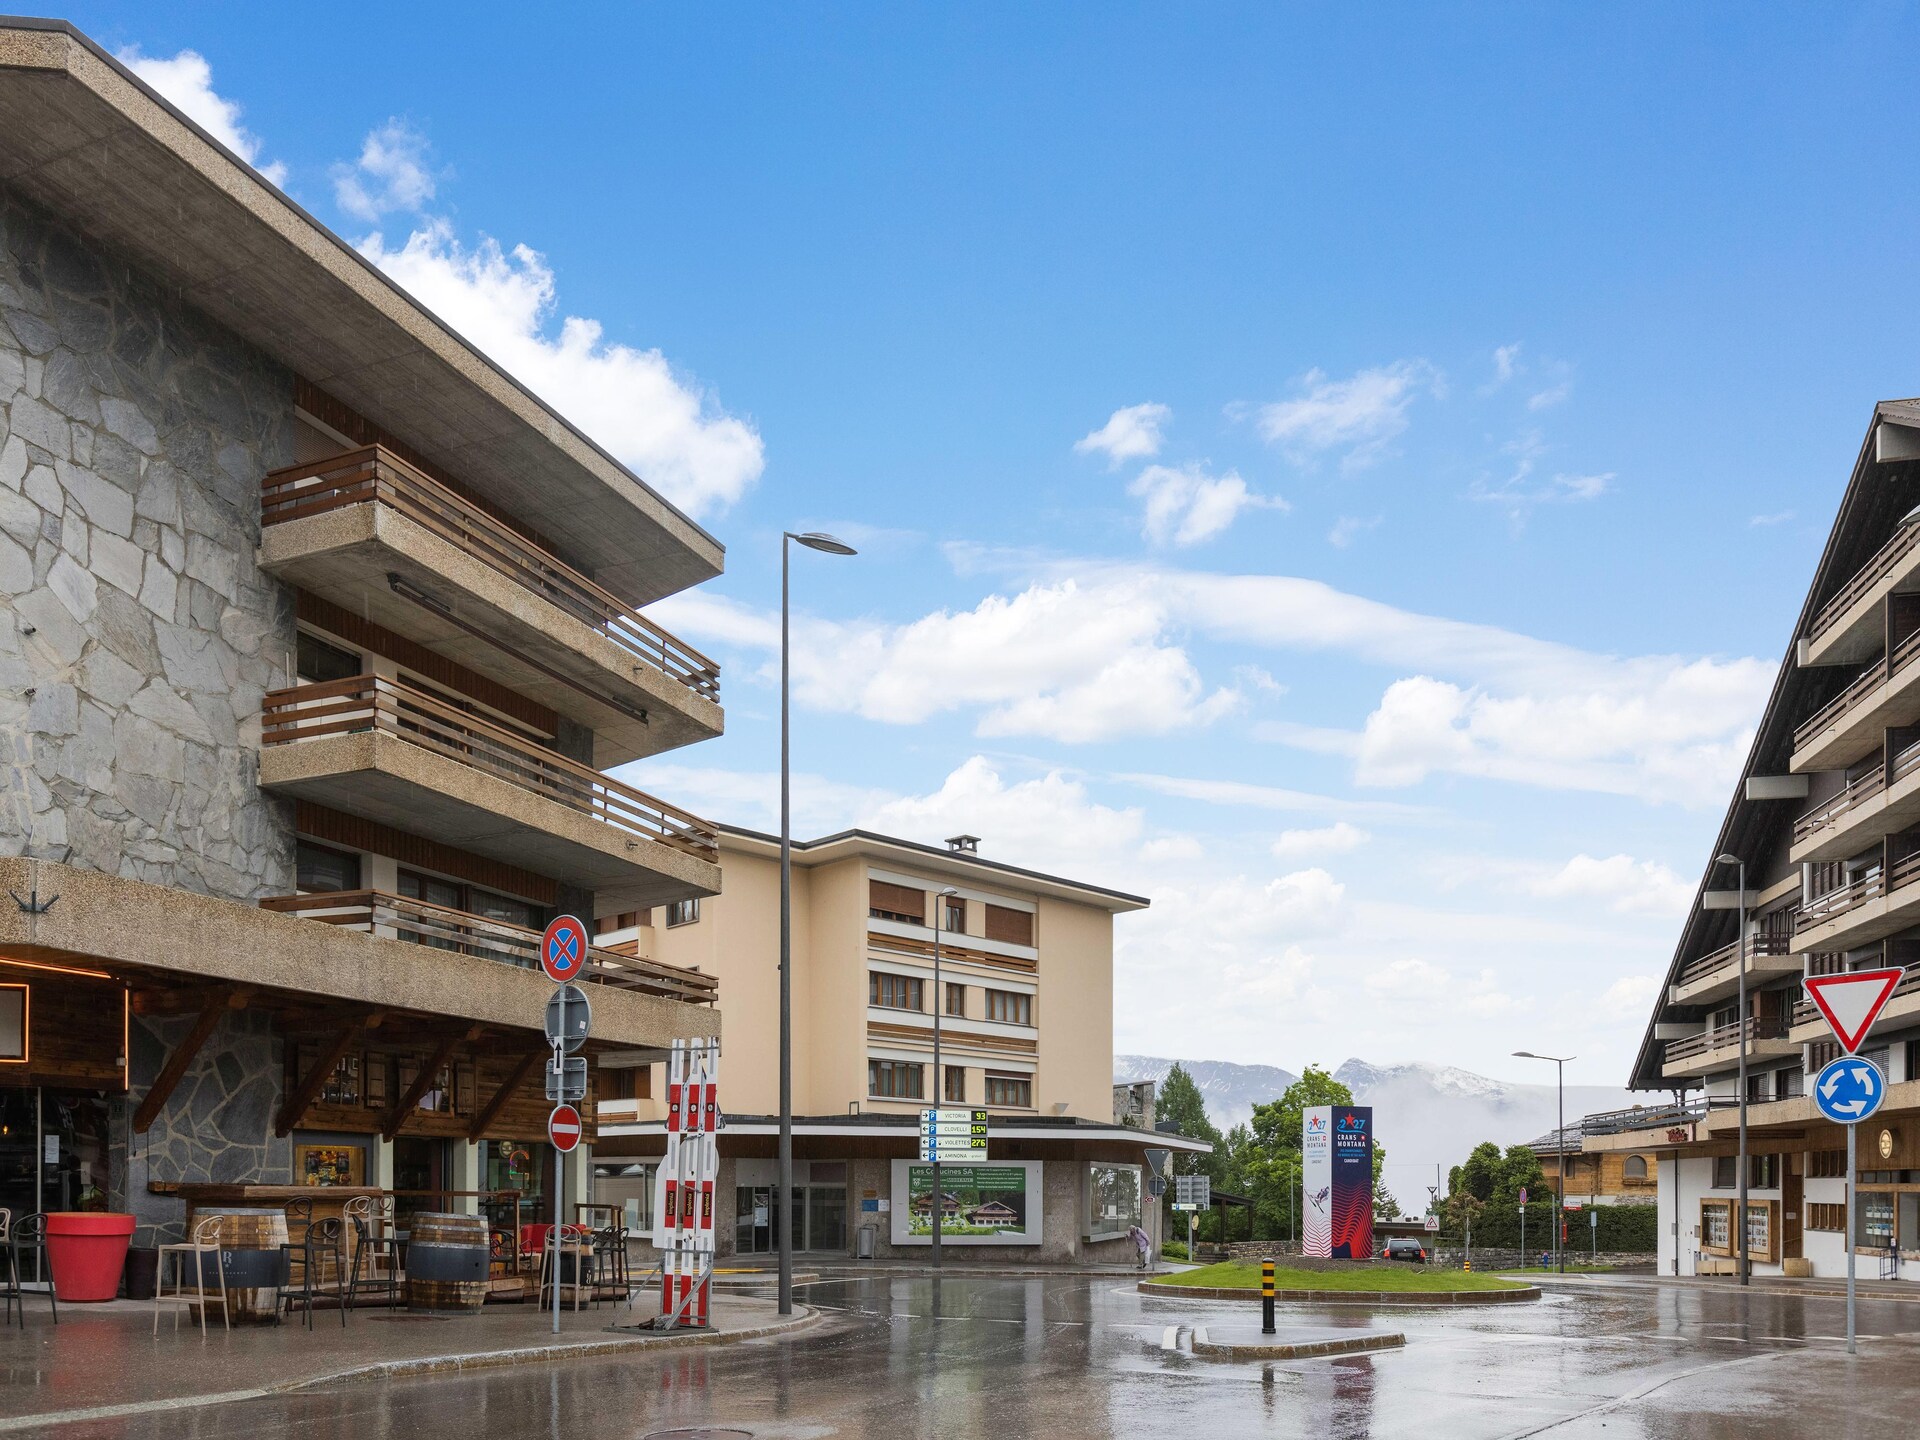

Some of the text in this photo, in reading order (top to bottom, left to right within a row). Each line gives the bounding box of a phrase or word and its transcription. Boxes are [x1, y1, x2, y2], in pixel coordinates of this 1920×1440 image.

[976, 1112, 986, 1120] 93
[971, 1125, 986, 1134] 154
[971, 1139, 986, 1147] 276
[223, 1251, 232, 1264] R
